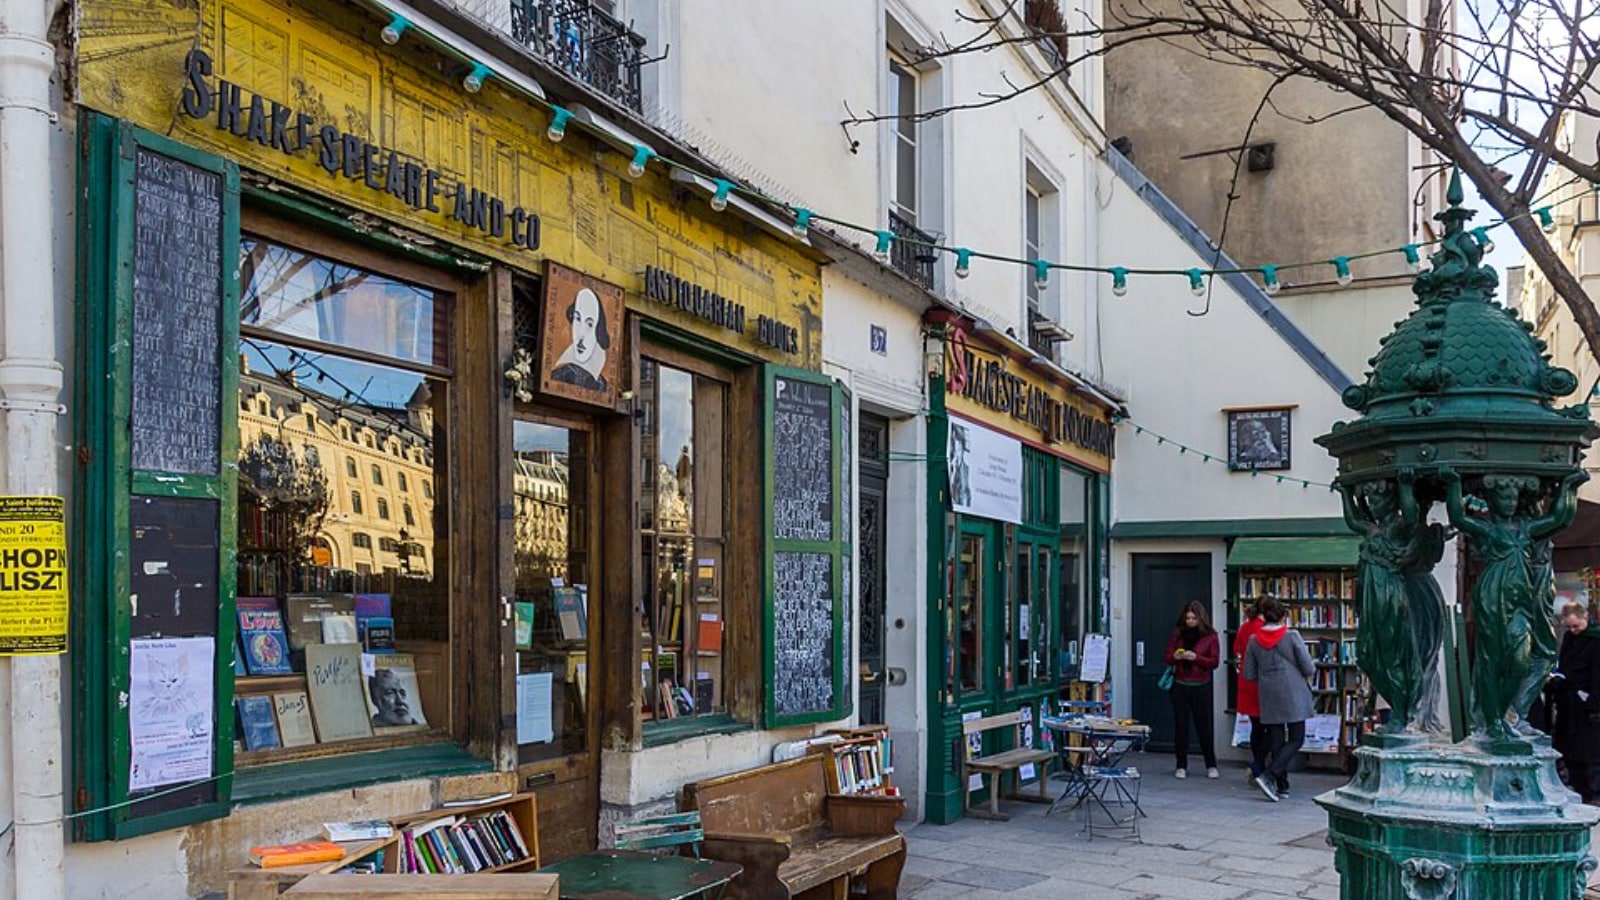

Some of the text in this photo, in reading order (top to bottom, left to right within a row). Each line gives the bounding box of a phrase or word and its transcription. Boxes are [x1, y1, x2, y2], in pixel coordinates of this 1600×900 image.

[183, 50, 540, 251] SHAKESPEARE AND CO
[138, 152, 219, 200] PARIS WALL
[645, 264, 746, 334] ANTIQUARIAN
[757, 313, 798, 356] BOOKS
[20, 524, 34, 534] 20
[0, 571, 63, 591] LISZT
